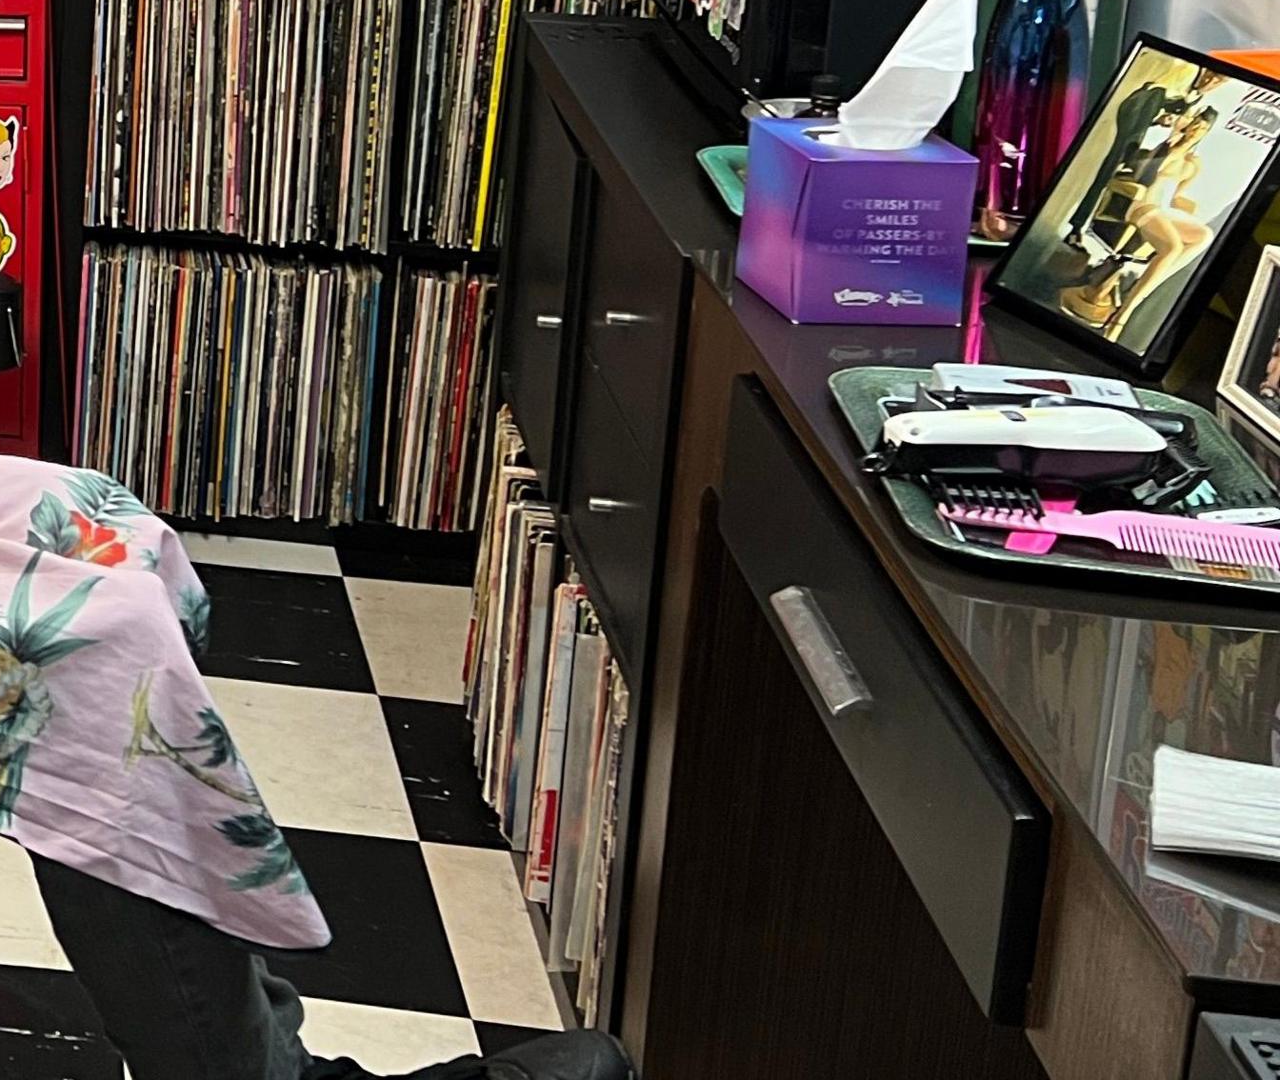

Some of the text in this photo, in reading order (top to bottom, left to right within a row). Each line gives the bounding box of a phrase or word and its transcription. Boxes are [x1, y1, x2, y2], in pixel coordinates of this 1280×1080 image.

[842, 199, 942, 211] CHERISH THE
[866, 214, 919, 226] SMILES
[833, 228, 945, 241] OF PASSERS-BY
[895, 244, 924, 256] THE
